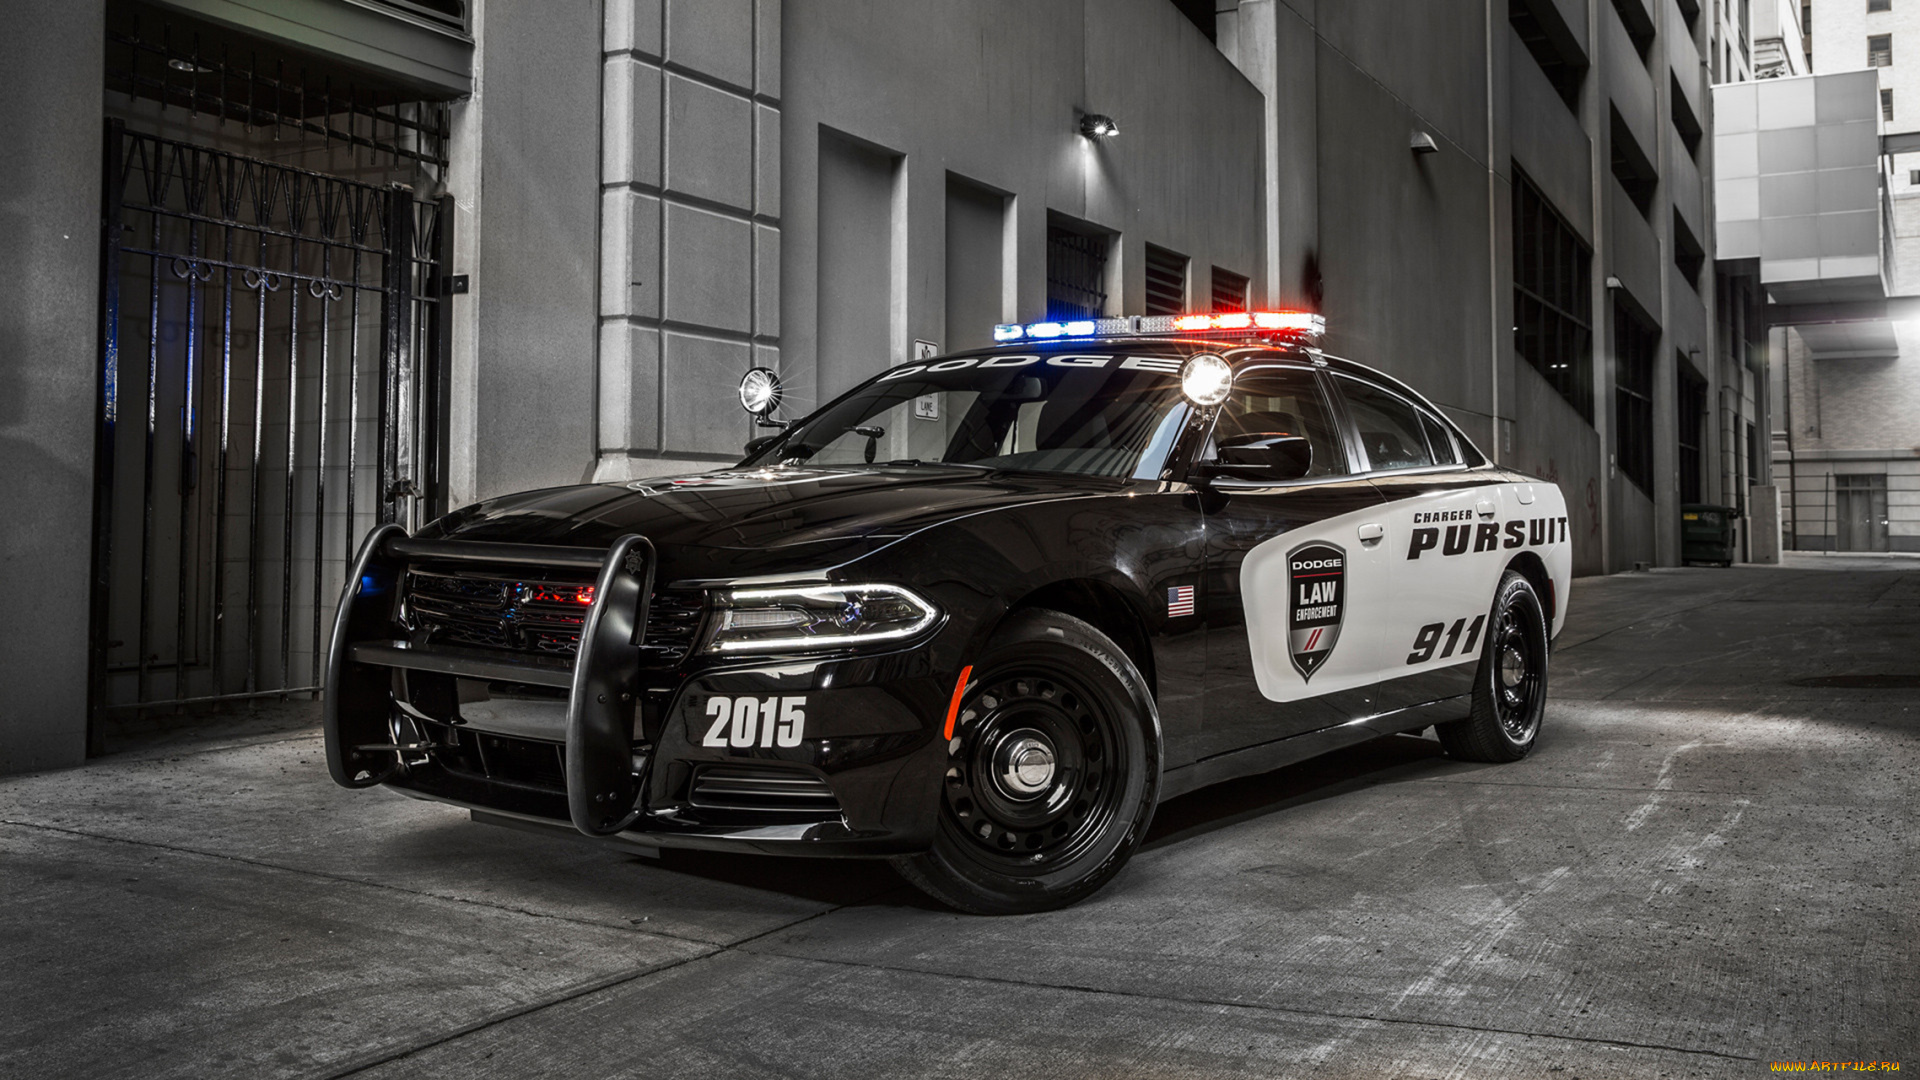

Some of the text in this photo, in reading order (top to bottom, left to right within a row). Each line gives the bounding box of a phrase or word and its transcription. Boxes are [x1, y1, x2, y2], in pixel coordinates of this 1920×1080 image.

[876, 355, 1183, 382] DODGE
[921, 401, 933, 412] LANE
[1414, 509, 1473, 524] CHARGER
[1407, 517, 1567, 560] PURSUIT
[1292, 559, 1342, 570] DODGE
[1300, 581, 1337, 605] LAW
[1296, 605, 1338, 621] ENFORCEMENT
[1406, 614, 1486, 665] 911
[702, 696, 807, 748] 2015
